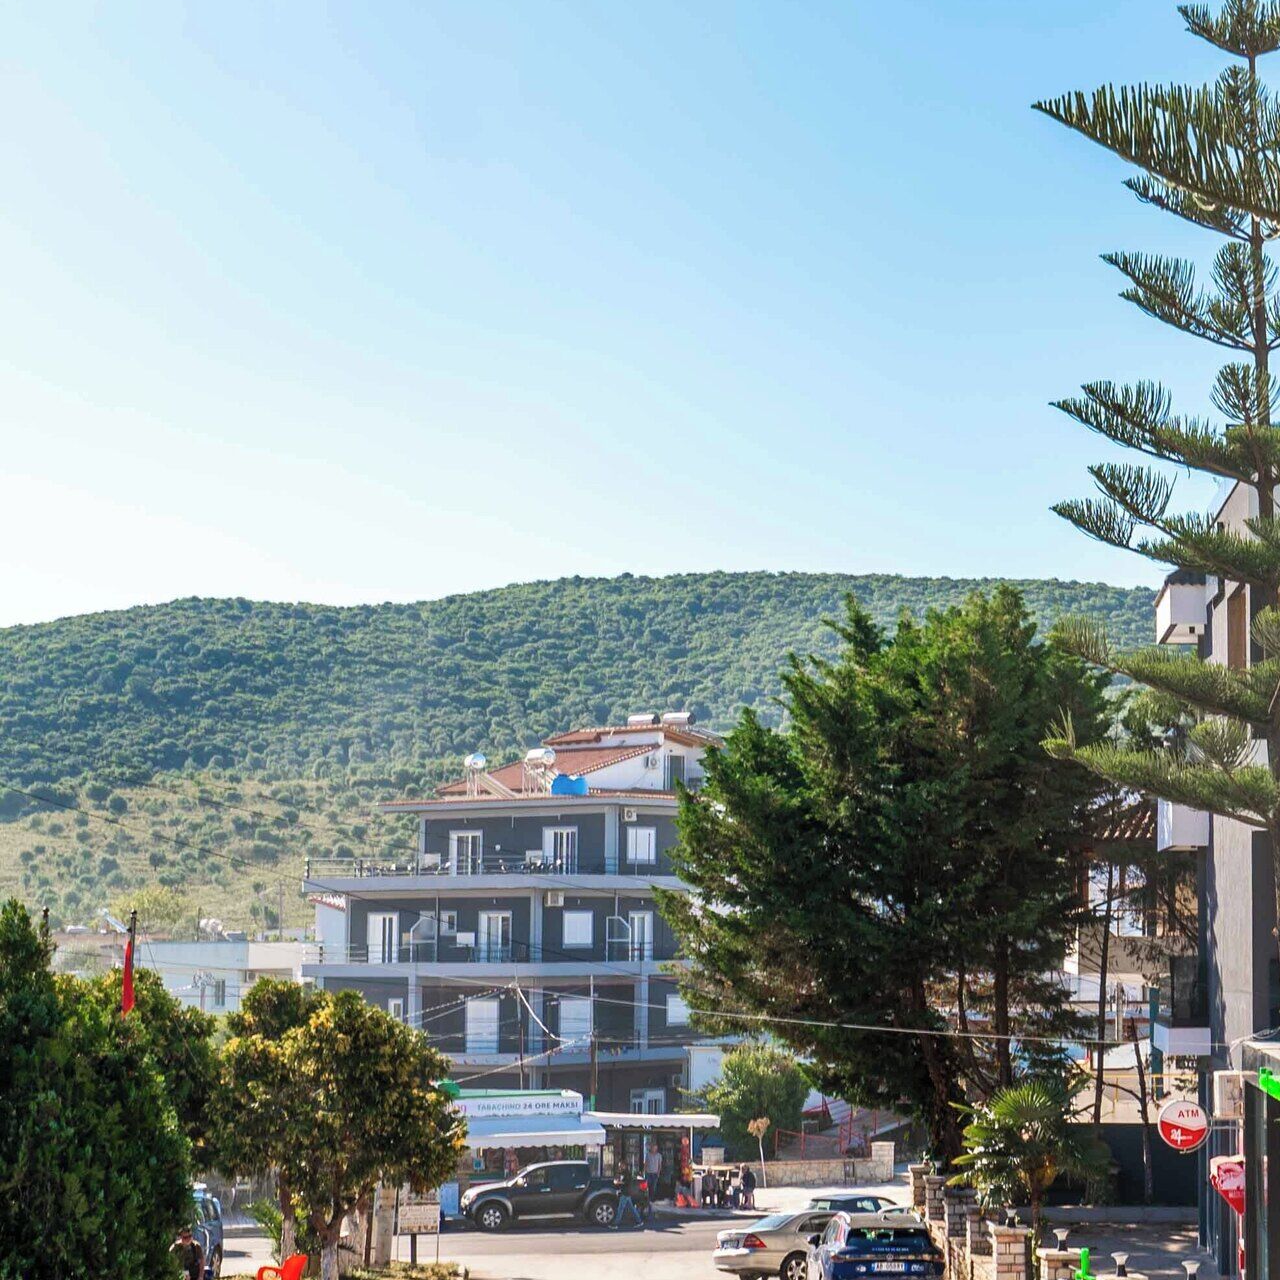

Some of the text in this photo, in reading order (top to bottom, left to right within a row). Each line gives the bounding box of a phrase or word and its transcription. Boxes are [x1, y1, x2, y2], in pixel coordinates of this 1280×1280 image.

[535, 1102, 551, 1110] ORE
[553, 1101, 578, 1109] MAKSI
[1178, 1109, 1199, 1118] ATM
